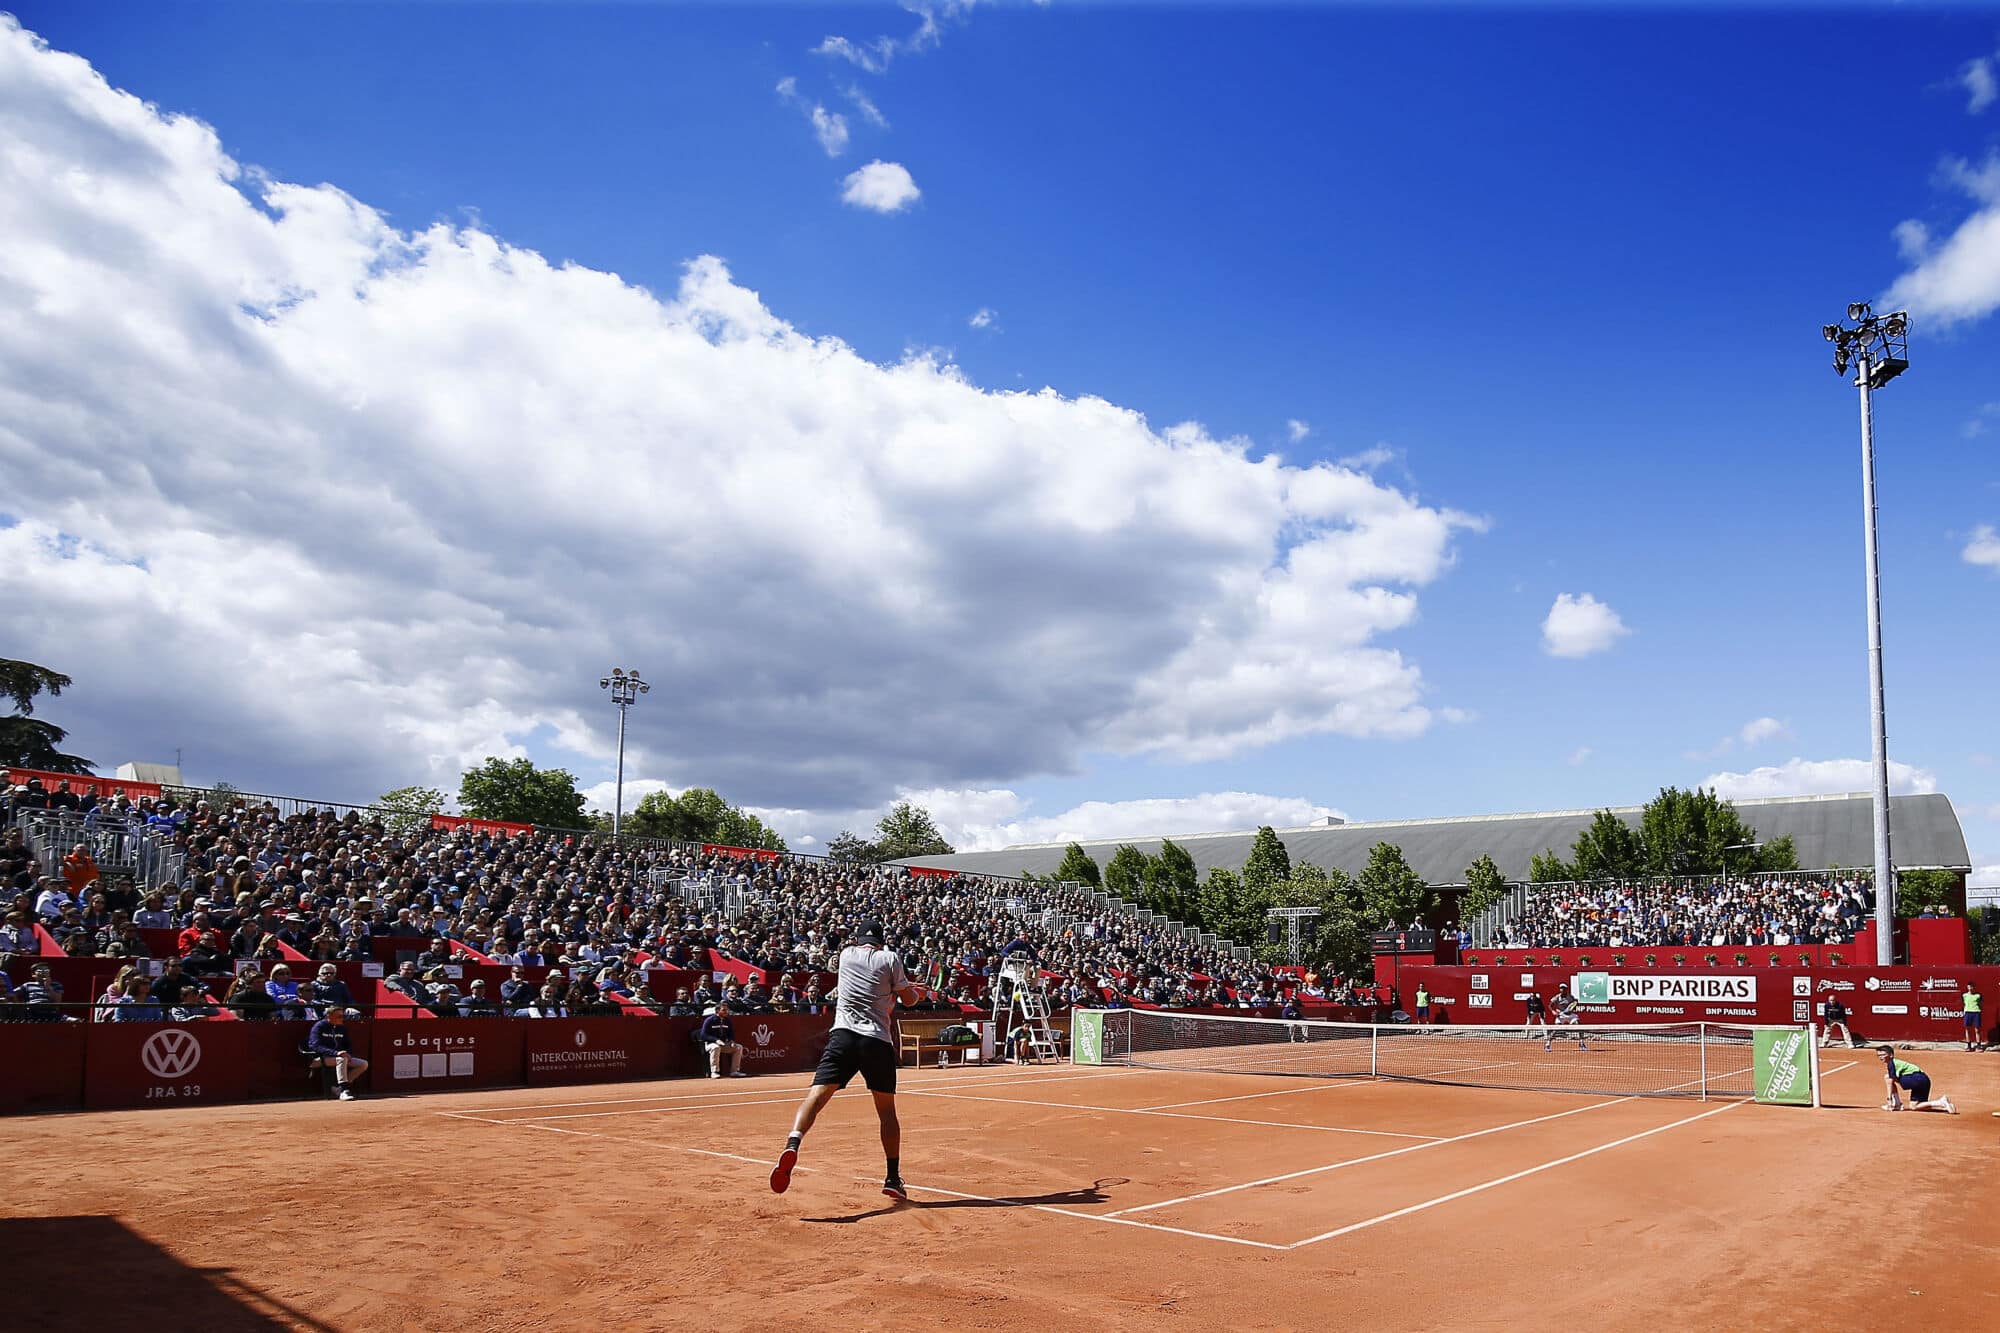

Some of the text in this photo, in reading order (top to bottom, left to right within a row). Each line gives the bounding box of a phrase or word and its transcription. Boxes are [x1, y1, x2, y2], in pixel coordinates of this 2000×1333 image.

[1613, 979, 1749, 997] BNP PARIBAS
[1470, 995, 1491, 1004] TV7
[1723, 1008, 1757, 1016] PARIBAS
[393, 1032, 475, 1052] abaques
[1768, 1040, 1783, 1067] ATP
[1768, 1033, 1802, 1100] CHALLENGER
[1780, 1064, 1798, 1093] TOUR
[145, 1085, 201, 1098] JRA 33
